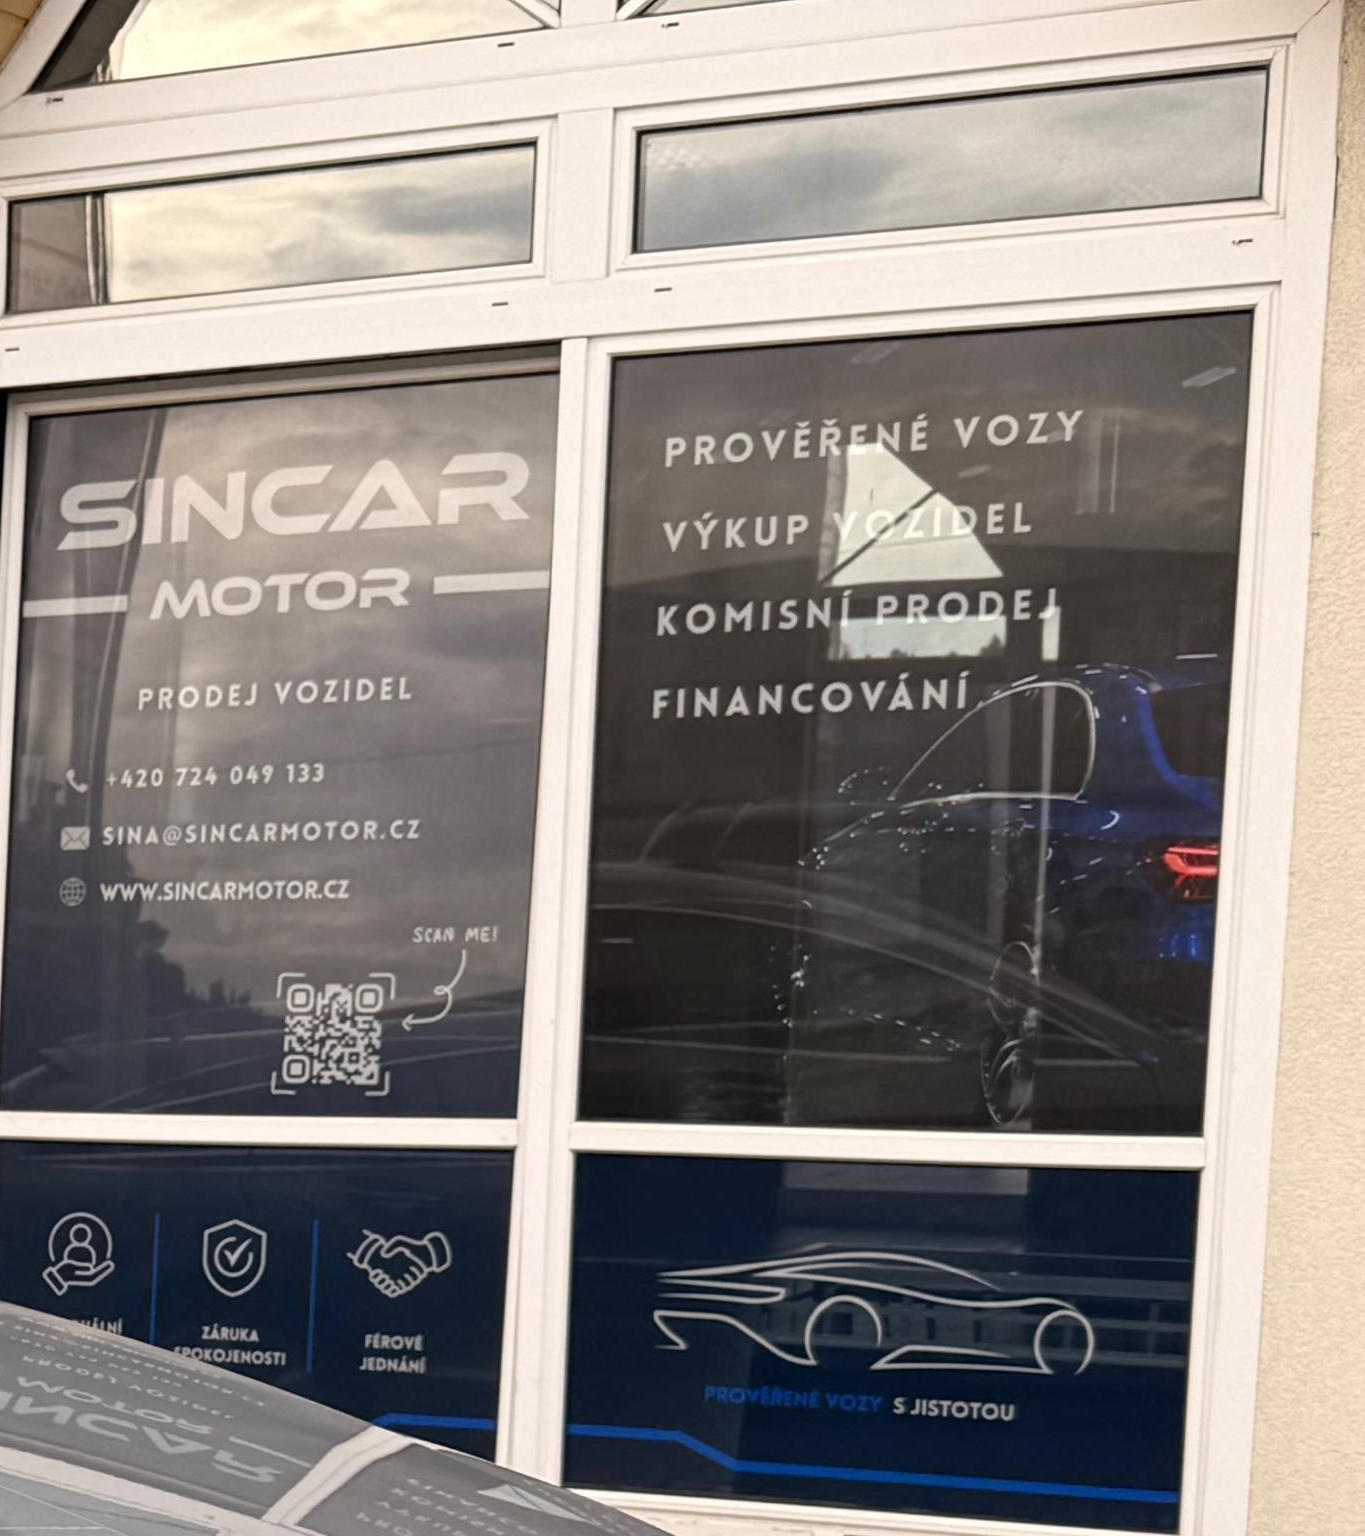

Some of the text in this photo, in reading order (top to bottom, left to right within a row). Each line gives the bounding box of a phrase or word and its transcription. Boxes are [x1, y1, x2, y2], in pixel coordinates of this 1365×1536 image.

[664, 410, 1085, 468] PROVĚŘENÉ VOZY
[56, 452, 531, 551] SINCAR
[662, 501, 1032, 553] VÝKUP VOZIDEL
[149, 568, 411, 620] MOTOR
[656, 588, 1059, 637] KOMISNÍ PRODEJ
[137, 677, 412, 711] PRODEJ VOZIDEL
[651, 672, 971, 720] FINANCOVÁNÍ
[107, 763, 325, 788] +420 724 049 133
[102, 819, 421, 846] SINA@SINCARMOTOR.CZ
[101, 879, 350, 903] WWW.SINCARMOTOR.CZ
[412, 926, 499, 944] SCAN ME!
[202, 1322, 260, 1343] ZÁRUKA
[364, 1330, 423, 1352] FÉROVÉ
[359, 1353, 427, 1375] JEDNÁNÍ
[704, 1384, 1016, 1422] PROVĚŘENÉ VOZY S JISTOTOU
